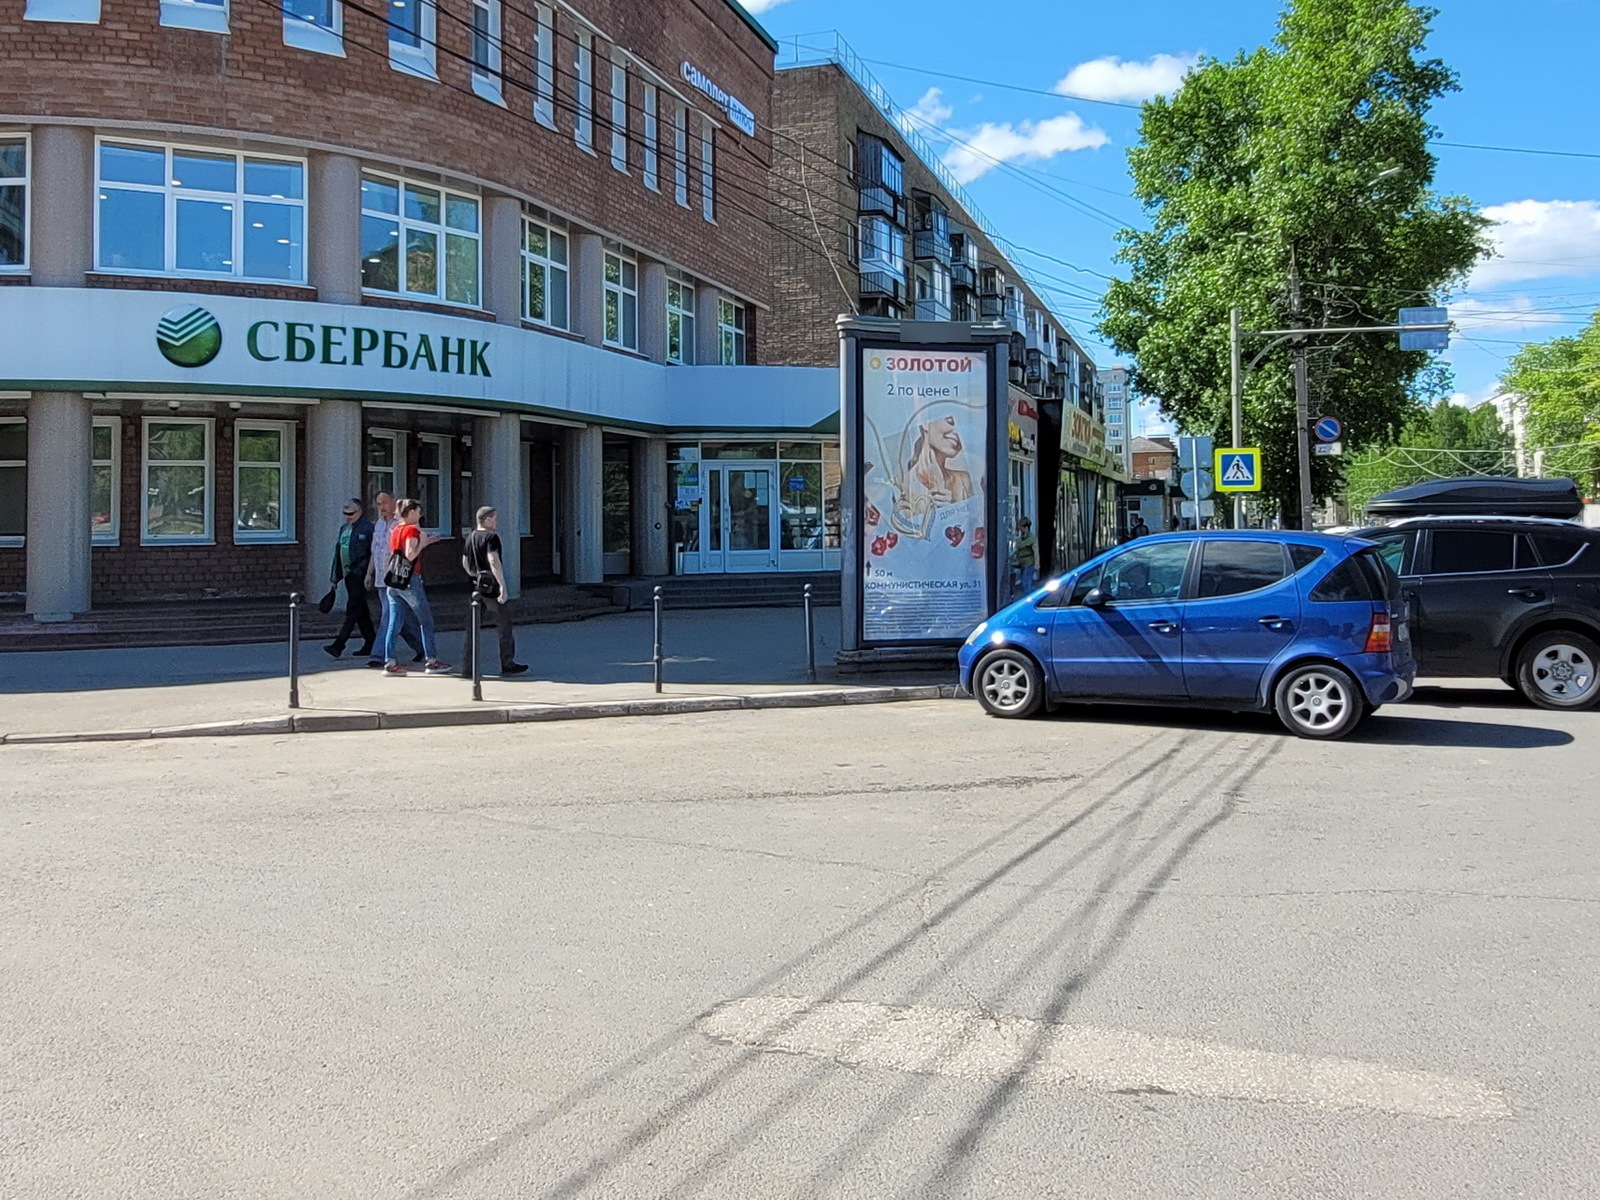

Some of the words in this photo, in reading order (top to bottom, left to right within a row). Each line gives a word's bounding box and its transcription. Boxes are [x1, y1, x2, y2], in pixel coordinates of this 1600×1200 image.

[247, 320, 493, 377] СБЕРБАНК
[886, 356, 972, 373] ЗОЛОТОЙ
[887, 383, 895, 396] 2
[897, 386, 914, 396] по
[917, 386, 951, 399] цене
[953, 385, 959, 397] 1
[874, 569, 885, 577] 50
[865, 580, 958, 590] КОММУНИСТИЧЕСКАЯ
[973, 580, 981, 588] 31
